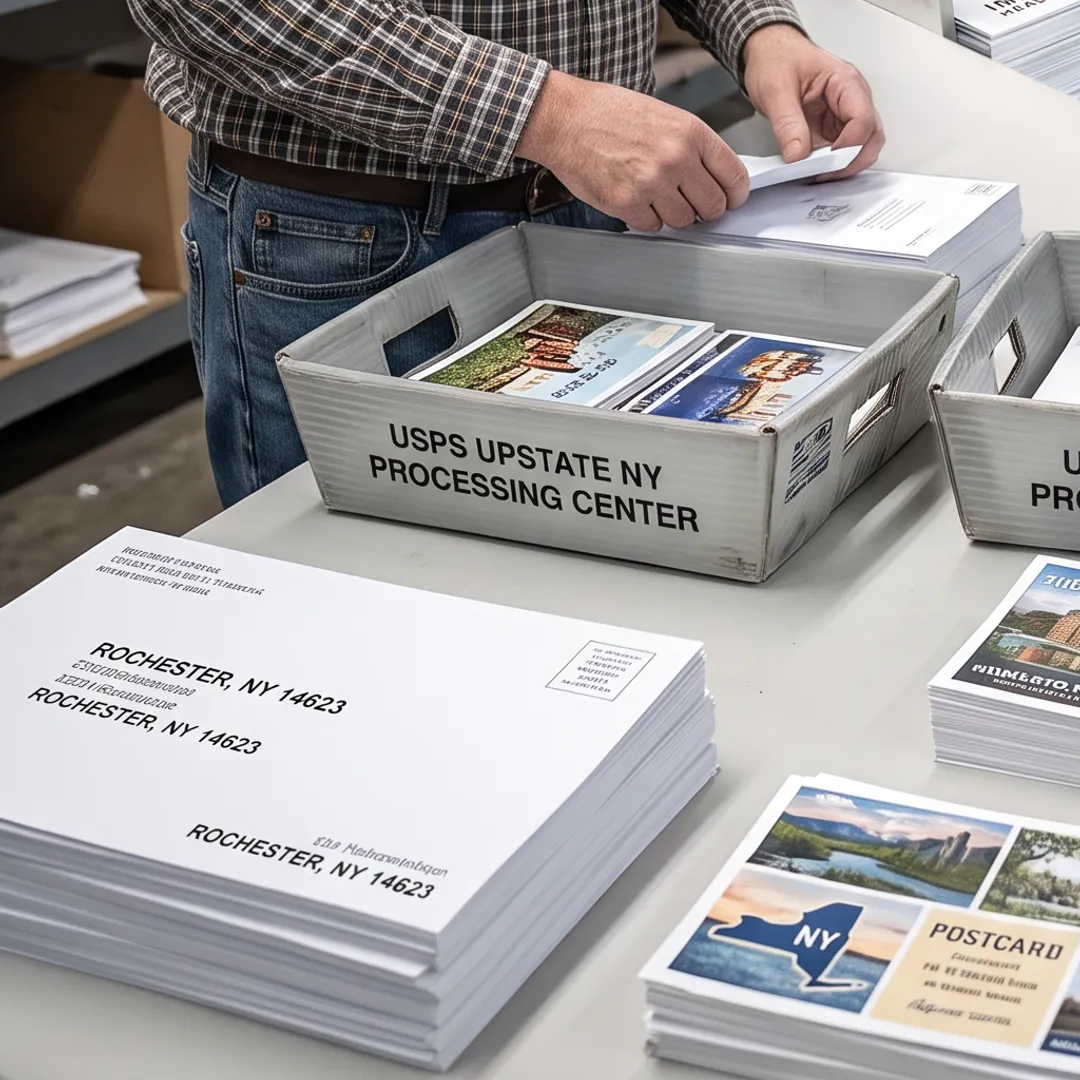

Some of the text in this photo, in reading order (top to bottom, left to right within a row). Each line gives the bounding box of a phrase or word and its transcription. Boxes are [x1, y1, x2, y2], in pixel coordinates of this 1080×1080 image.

[389, 423, 662, 490] USPS UPSTATE NY
[369, 454, 700, 532] PROCESSING CENTER
[90, 642, 234, 690] ROCHESTER,
[238, 678, 279, 697] NY
[279, 688, 347, 715] 14623
[27, 687, 158, 733] ROCHESTER,
[161, 721, 199, 737] NY
[198, 730, 262, 755] 14623
[186, 824, 325, 874] ROCHESTER,
[330, 861, 368, 880] NY
[369, 871, 435, 899] 14623
[793, 924, 841, 951] NY
[929, 923, 1064, 960] POSTCARD
